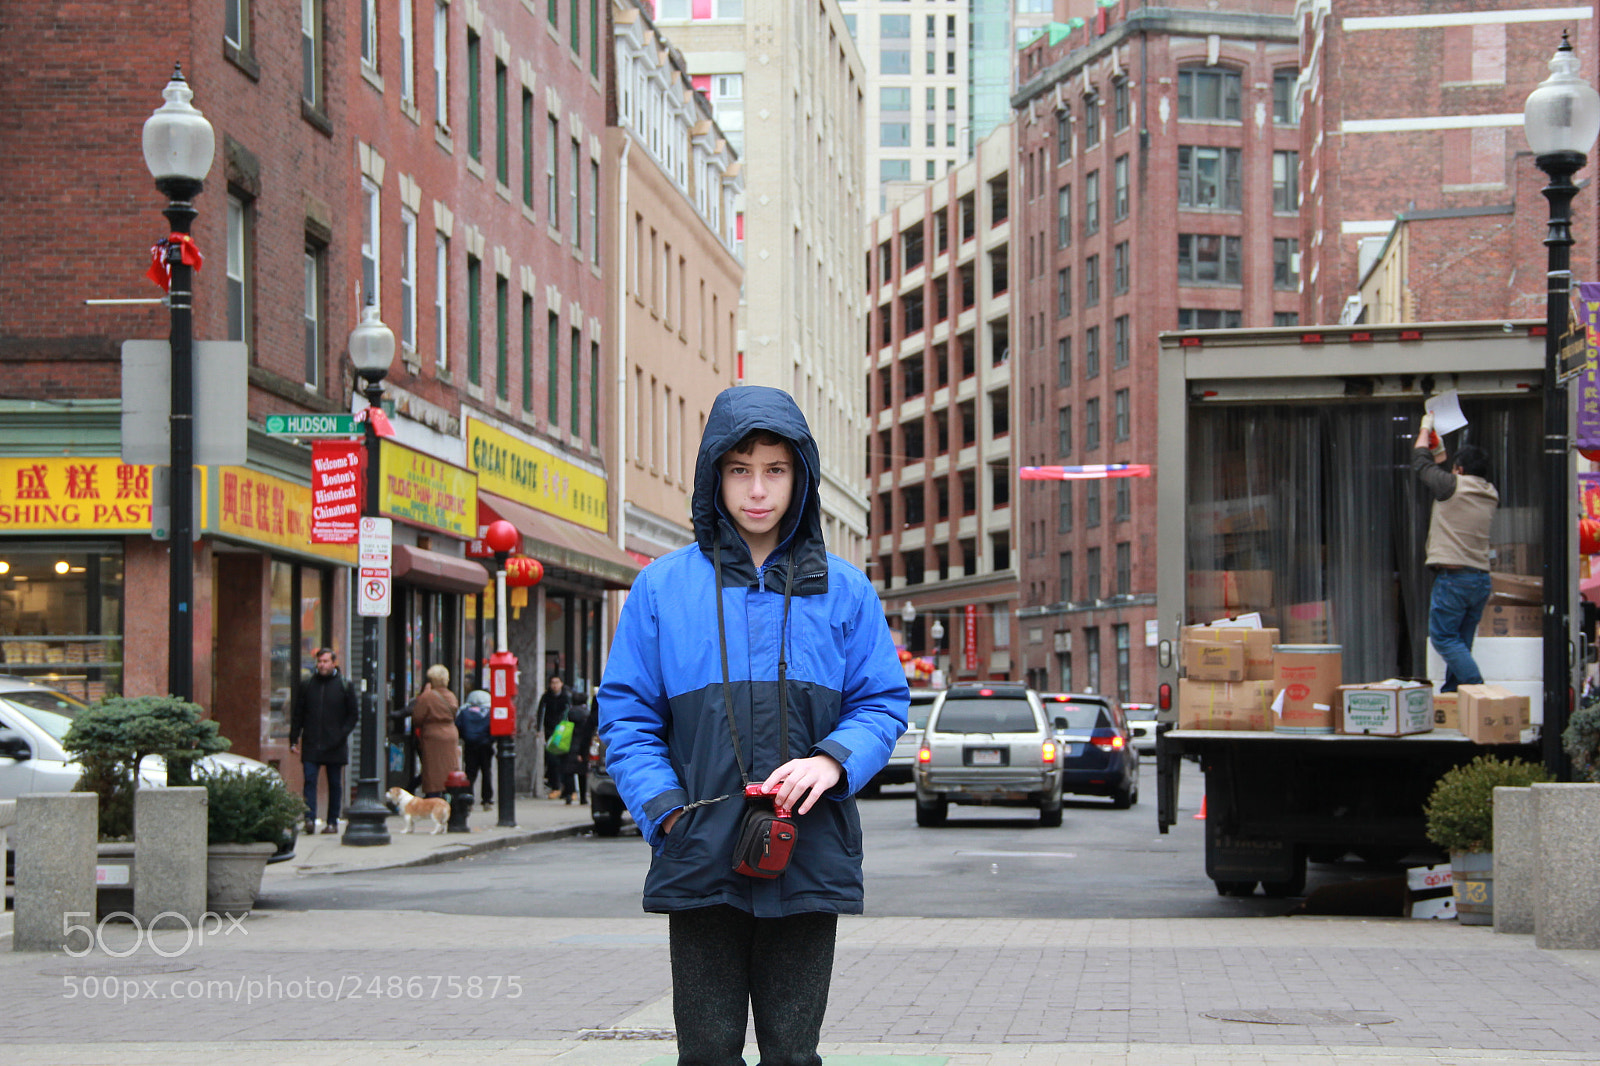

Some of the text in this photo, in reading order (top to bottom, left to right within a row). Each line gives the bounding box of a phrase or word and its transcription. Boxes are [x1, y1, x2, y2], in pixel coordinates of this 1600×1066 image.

[1586, 301, 1599, 382] WELCOME
[288, 416, 358, 432] HUDSON ST
[314, 452, 359, 472] Welcome To
[473, 436, 507, 478] GREAT
[511, 452, 538, 490] TASTE
[321, 470, 356, 487] Boston's
[315, 484, 357, 504] Historical
[0, 504, 80, 524] SHING
[313, 503, 357, 520] Chinatown
